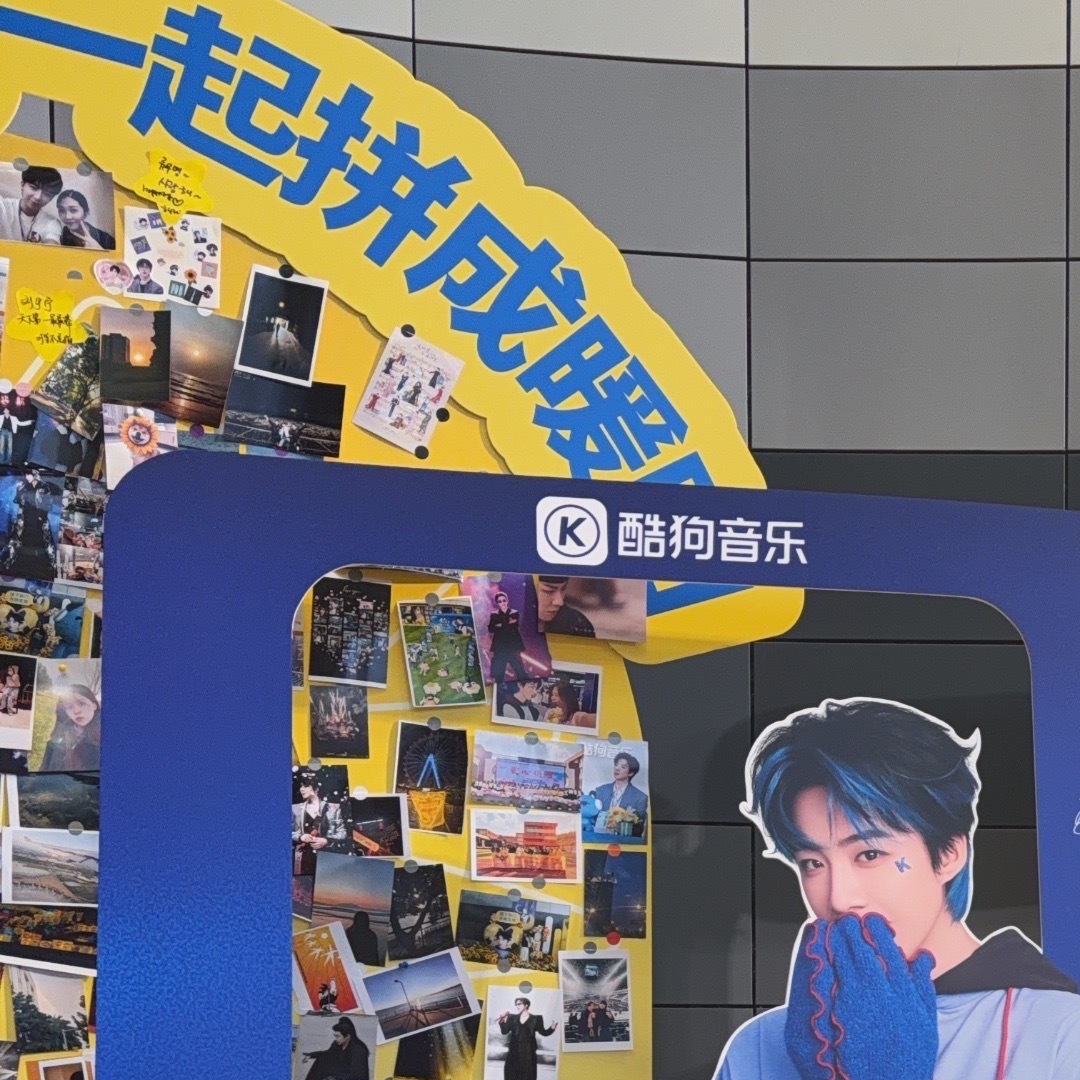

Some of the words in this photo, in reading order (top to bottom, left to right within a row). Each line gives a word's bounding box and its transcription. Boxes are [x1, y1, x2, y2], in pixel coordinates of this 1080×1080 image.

[0, 4, 718, 488] 一起拼成暖
[617, 511, 808, 565] 酷狗音乐
